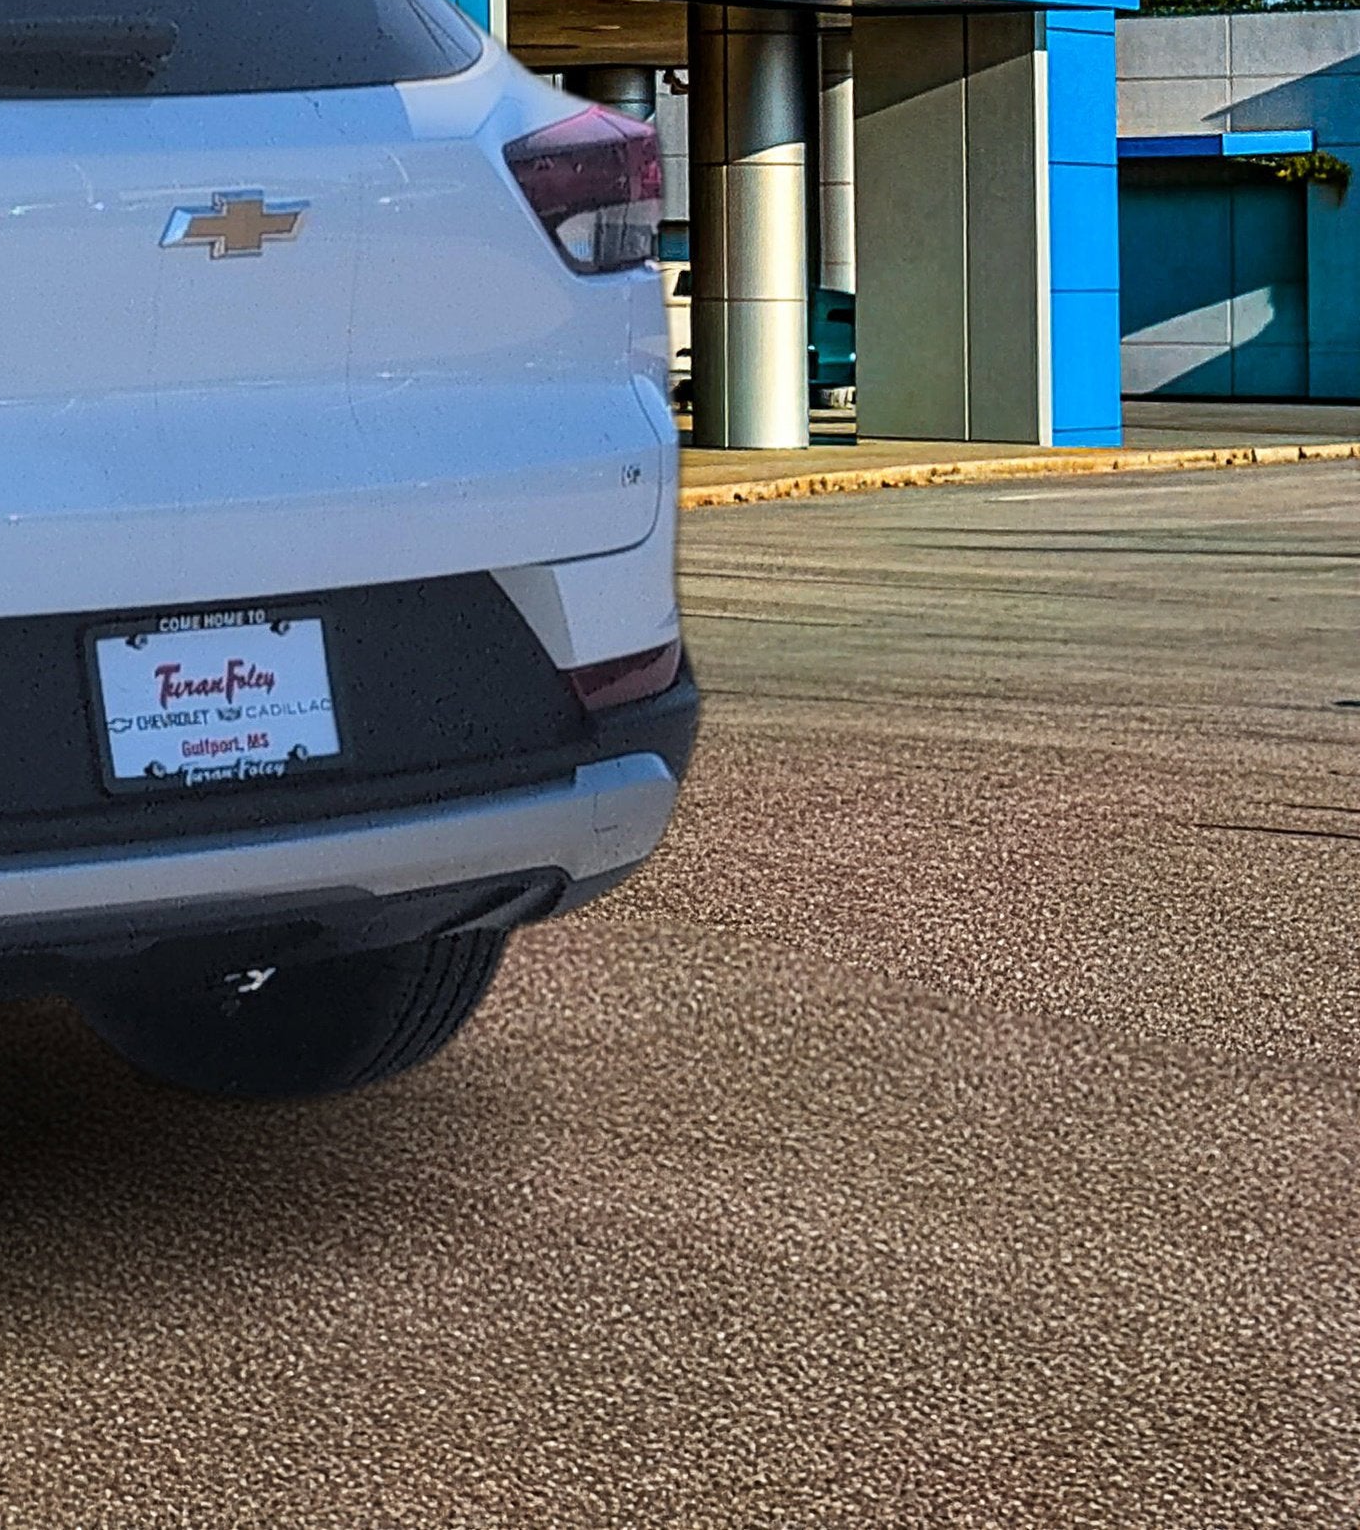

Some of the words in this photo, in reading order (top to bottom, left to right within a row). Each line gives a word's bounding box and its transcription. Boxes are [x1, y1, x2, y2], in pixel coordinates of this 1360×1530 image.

[159, 613, 201, 632] COME
[203, 610, 243, 628] HOME
[247, 609, 266, 624] TO
[136, 710, 209, 731] CHEVROLET
[246, 698, 330, 719] CADILLAC
[247, 732, 270, 750] MS
